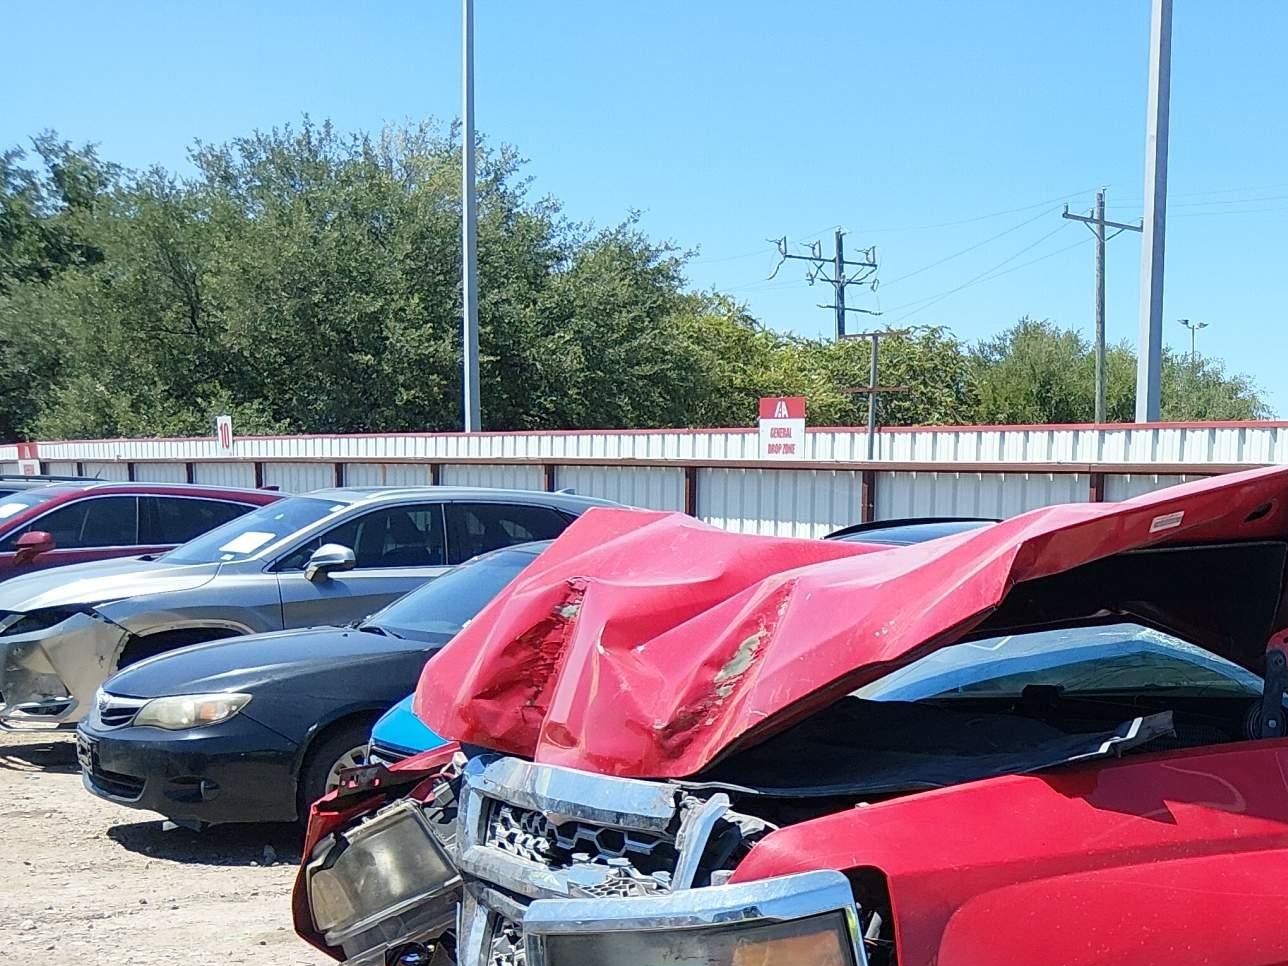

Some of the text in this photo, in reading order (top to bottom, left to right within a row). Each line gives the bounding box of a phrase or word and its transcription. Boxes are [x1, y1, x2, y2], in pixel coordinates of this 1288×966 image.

[220, 423, 230, 449] 10
[770, 427, 792, 439] GENERAL
[767, 443, 796, 455] DROP ZONE
